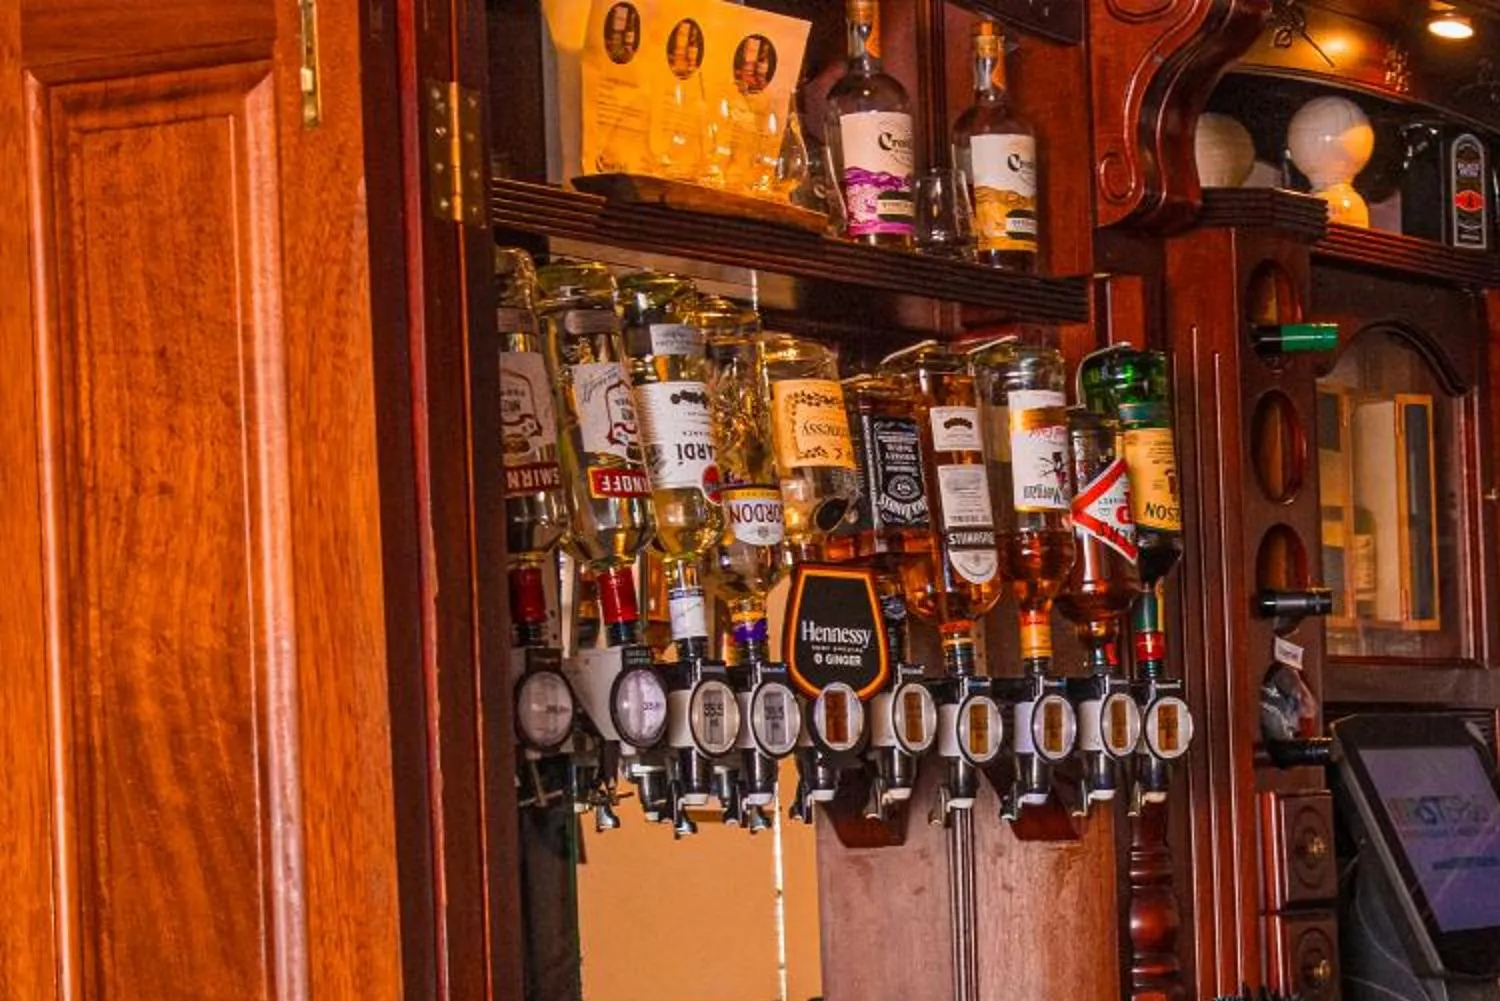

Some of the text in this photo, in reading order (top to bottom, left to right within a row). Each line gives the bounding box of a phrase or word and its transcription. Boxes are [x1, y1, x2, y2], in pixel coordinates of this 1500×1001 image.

[728, 503, 782, 524] ORDON
[801, 619, 872, 649] Hennessy
[825, 653, 862, 668] GINGER
